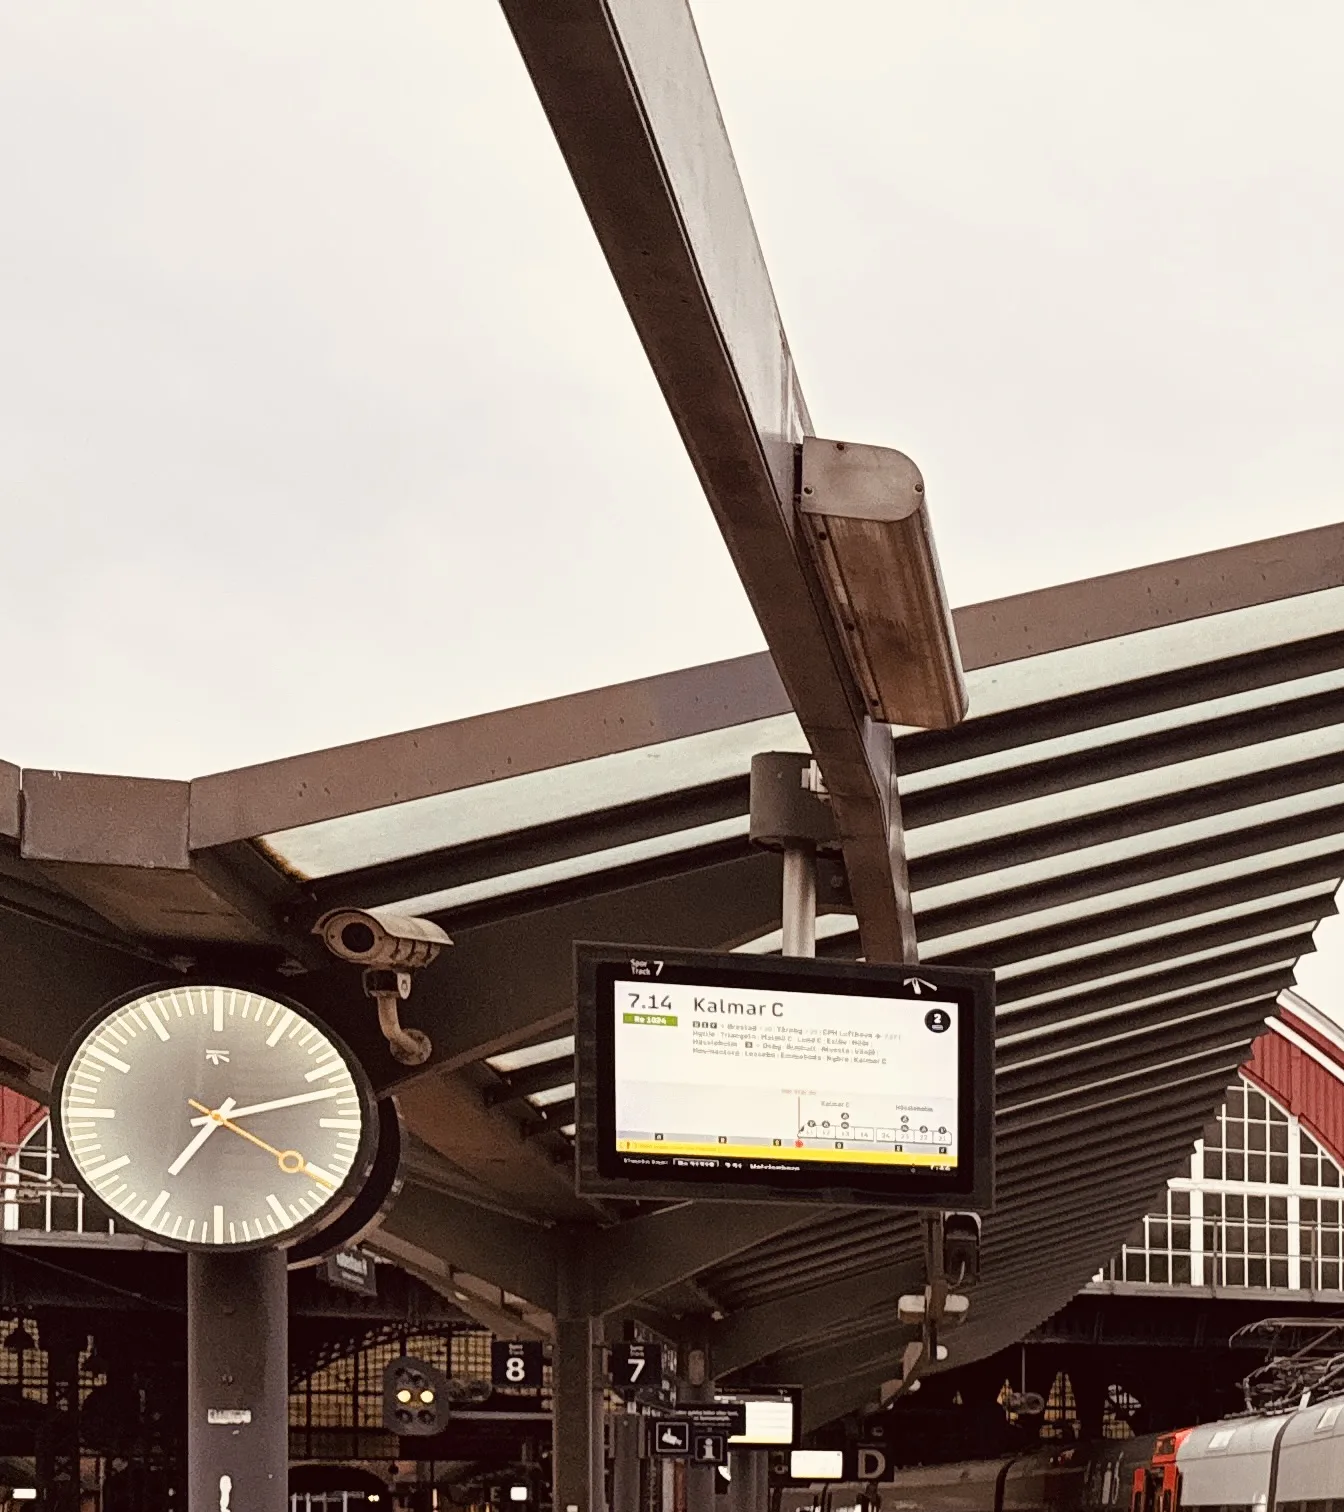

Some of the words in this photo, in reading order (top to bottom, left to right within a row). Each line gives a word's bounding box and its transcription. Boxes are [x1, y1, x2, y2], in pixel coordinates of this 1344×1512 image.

[654, 961, 664, 976] 7
[628, 993, 672, 1010] 7.14
[694, 997, 766, 1016] Kalmar
[772, 1003, 784, 1017] C
[934, 1013, 942, 1024] 2
[506, 1358, 525, 1382] 8
[628, 1358, 645, 1383] 7
[858, 1450, 885, 1478] D
